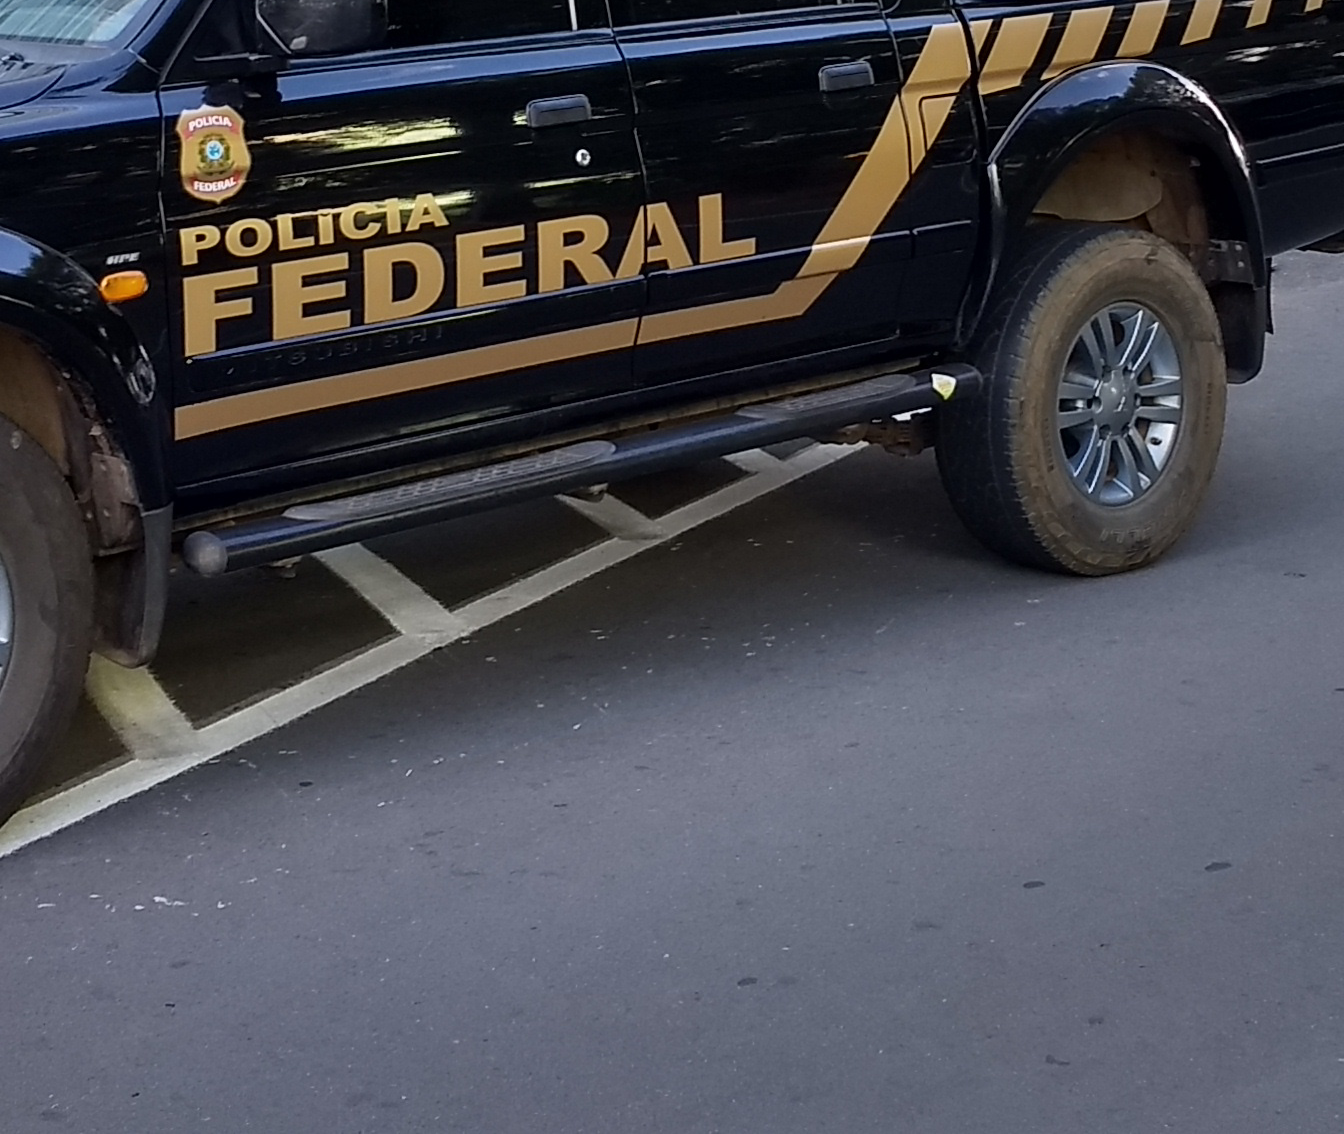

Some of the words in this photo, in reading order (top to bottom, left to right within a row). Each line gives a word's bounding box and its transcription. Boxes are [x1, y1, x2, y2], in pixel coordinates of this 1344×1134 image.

[188, 115, 232, 132] POLICIA
[193, 177, 236, 192] FEDERAL
[179, 193, 449, 265] POLICIA
[182, 192, 756, 358] FEDERAL
